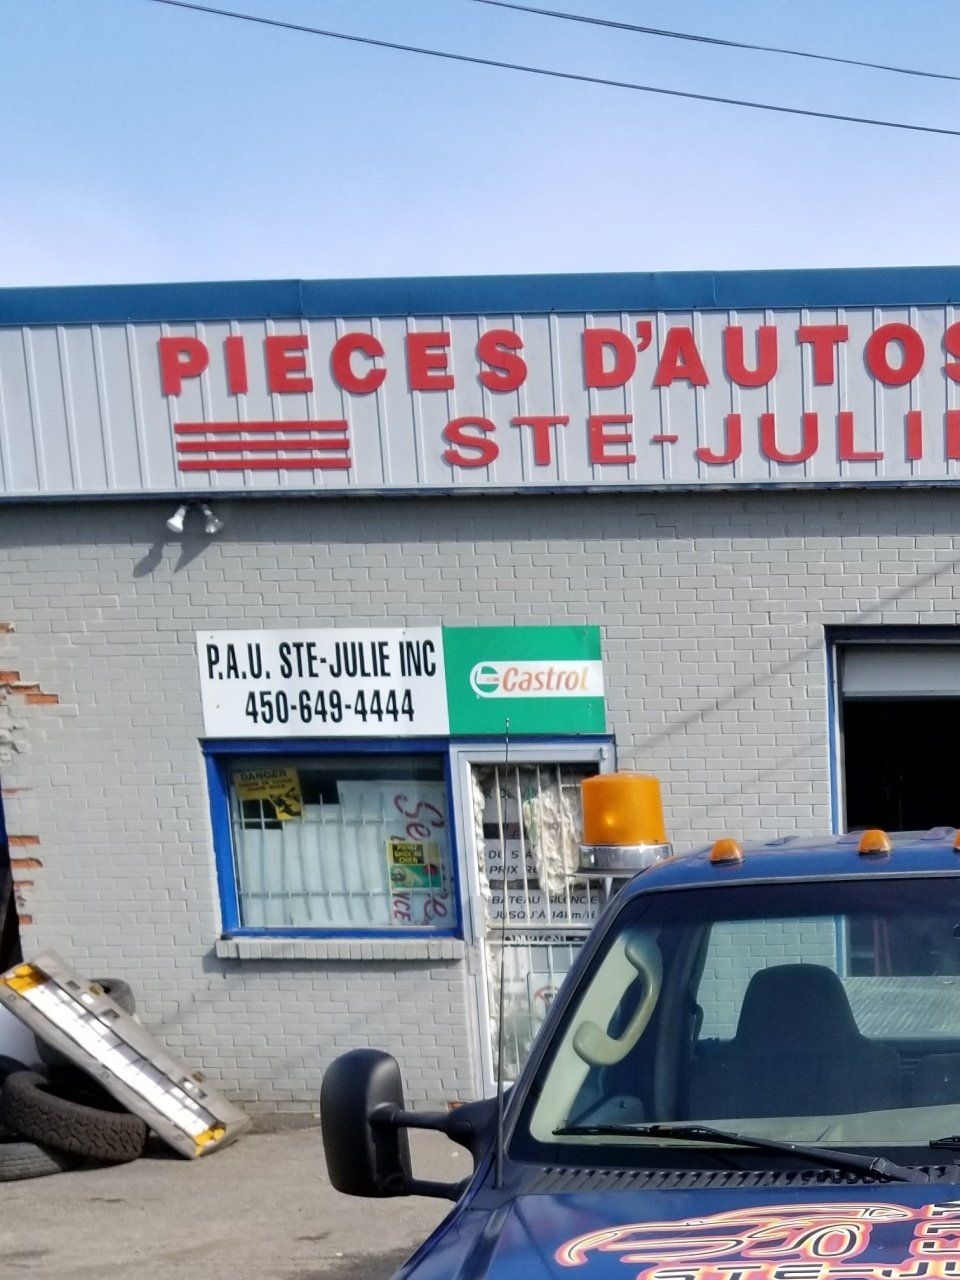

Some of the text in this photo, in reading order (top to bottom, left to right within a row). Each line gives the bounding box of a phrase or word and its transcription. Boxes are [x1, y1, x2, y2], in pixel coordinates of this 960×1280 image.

[159, 330, 528, 395] PIECES
[206, 639, 436, 680] P.A.U. STE-JULIE INC
[502, 666, 589, 692] Castrol
[245, 688, 415, 724] 450-649-4444
[491, 895, 541, 904] BTEAU
